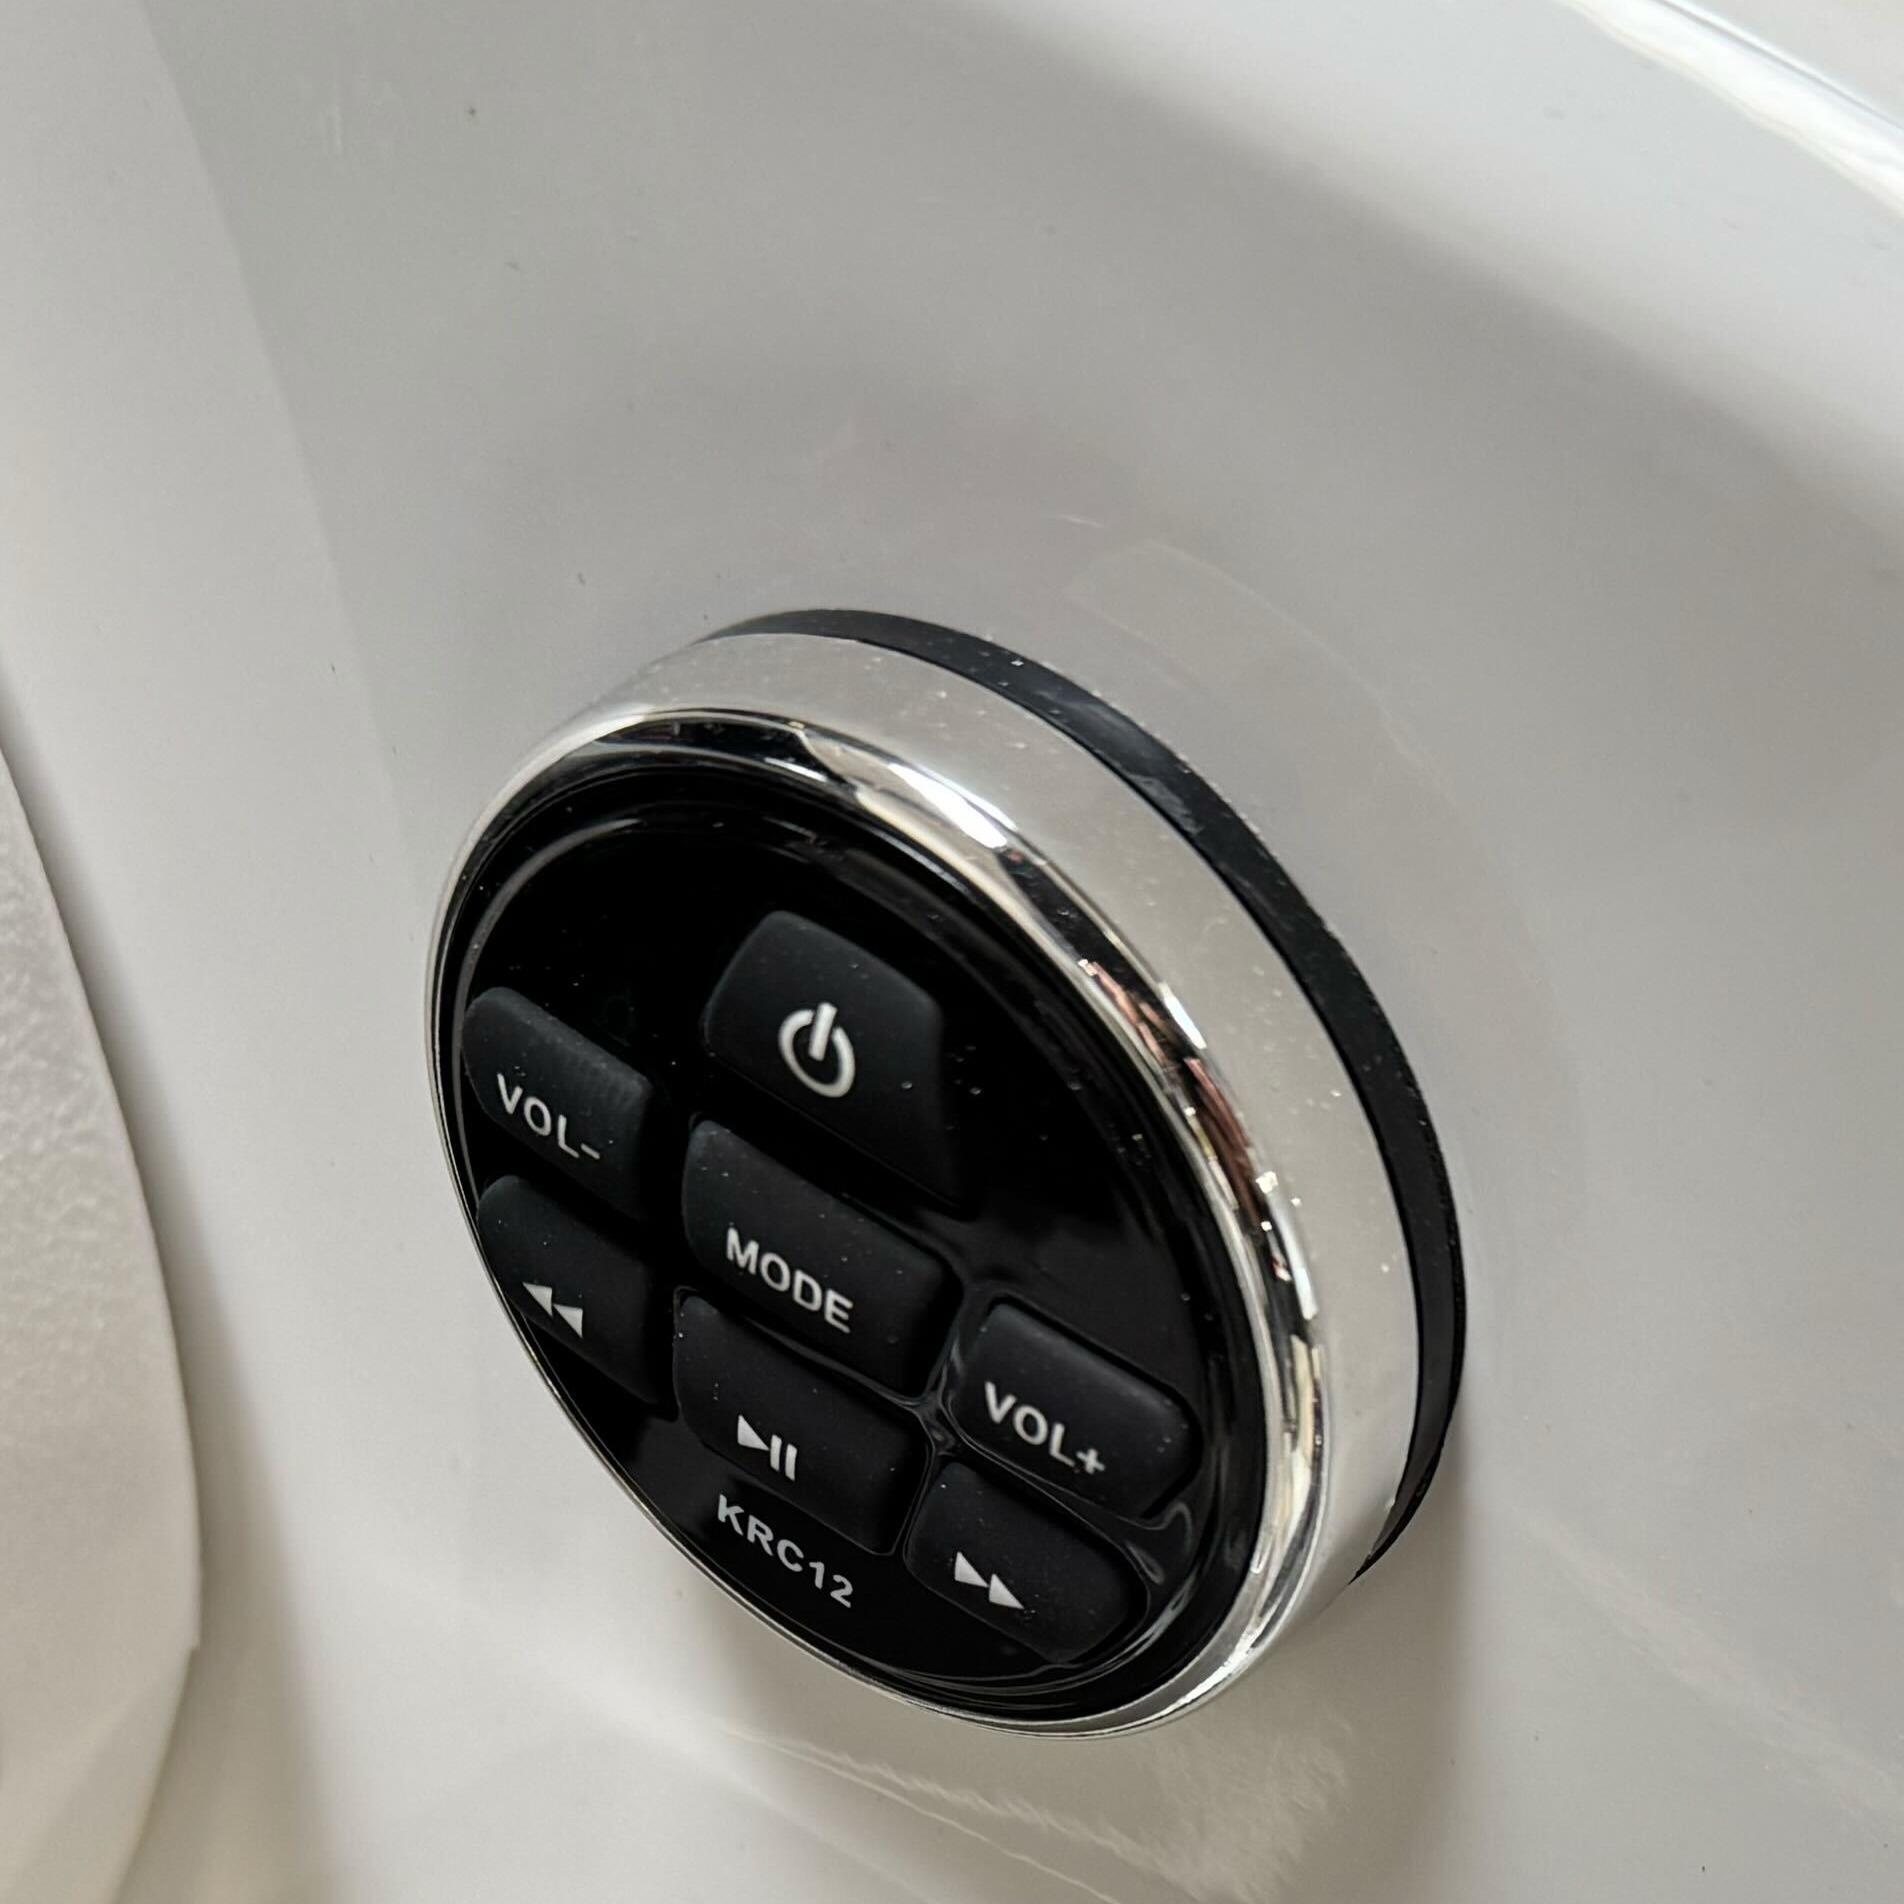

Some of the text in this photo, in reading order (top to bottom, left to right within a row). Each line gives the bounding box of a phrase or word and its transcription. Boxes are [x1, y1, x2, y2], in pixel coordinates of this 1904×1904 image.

[725, 1227, 854, 1333] MODE
[984, 1382, 1105, 1475] VOL+
[716, 1494, 854, 1608] KRC12
